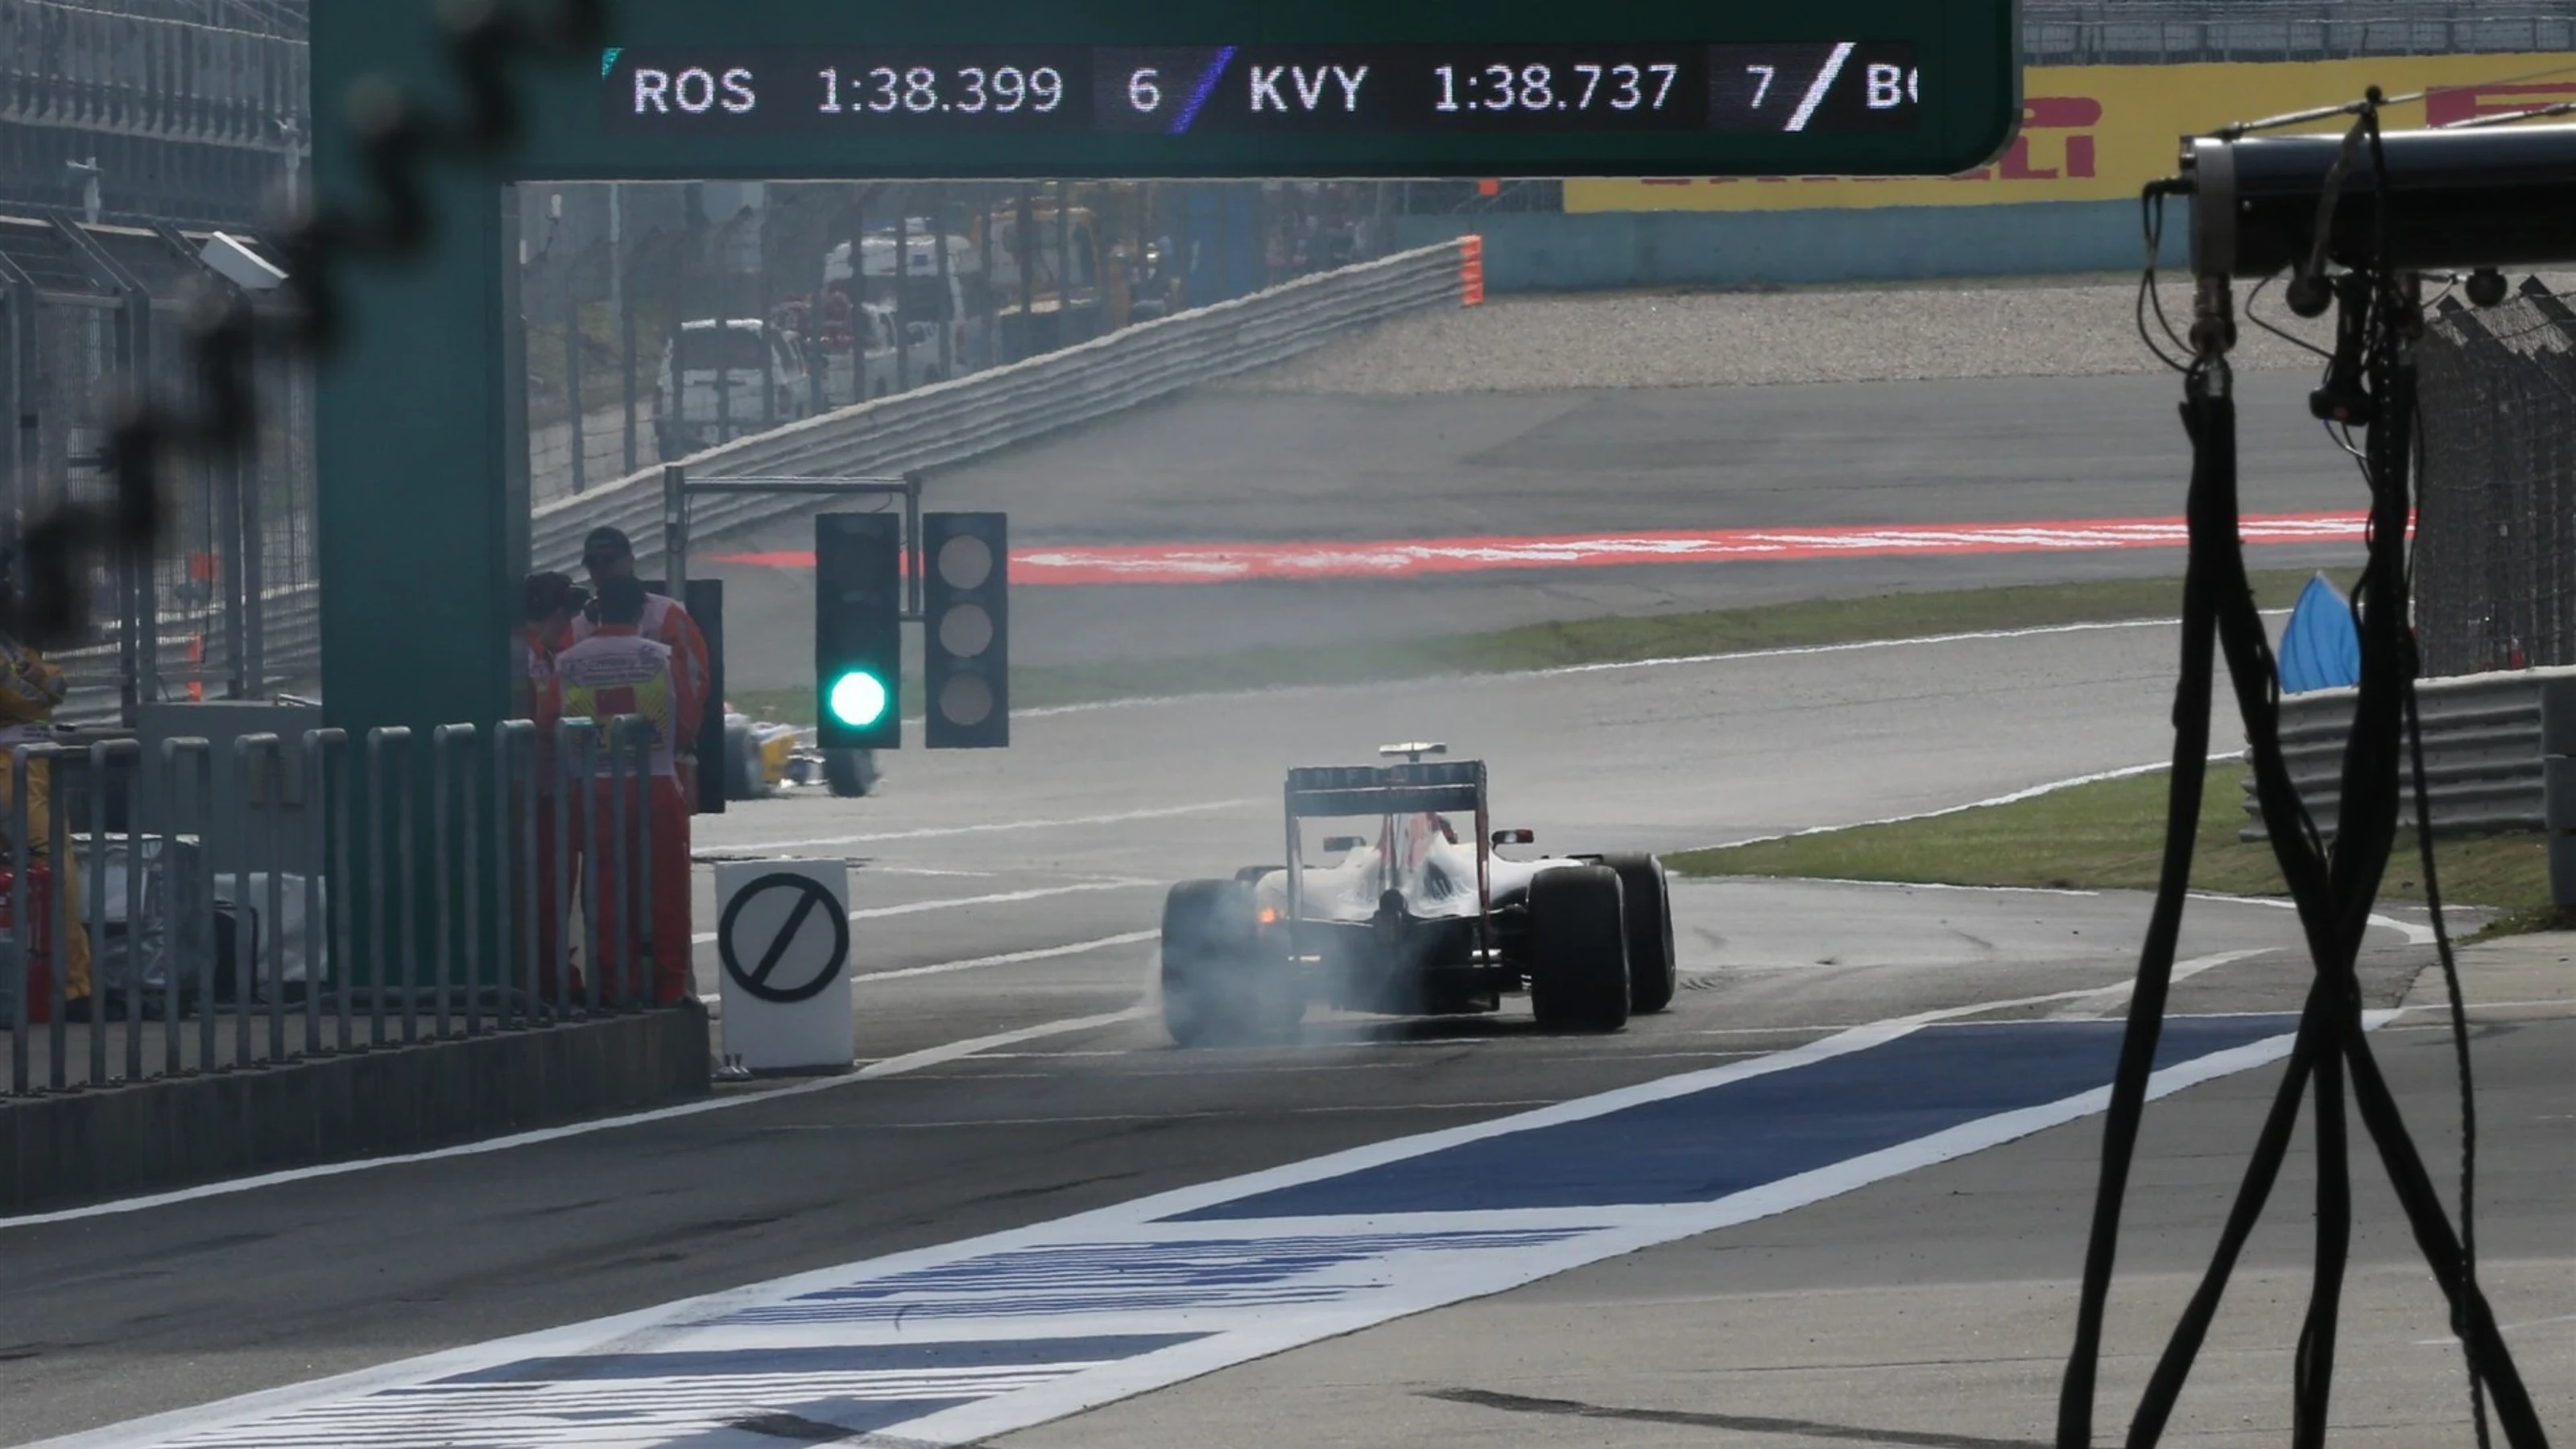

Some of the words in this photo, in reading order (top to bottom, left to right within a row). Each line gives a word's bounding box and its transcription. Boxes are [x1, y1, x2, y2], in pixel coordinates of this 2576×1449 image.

[635, 68, 755, 114] ROS
[819, 67, 1063, 114] 1:38.399
[1129, 68, 1161, 112] 6
[1251, 66, 1367, 112] KVY
[1437, 64, 1677, 111] 1:38.737
[1747, 65, 1774, 108] 7
